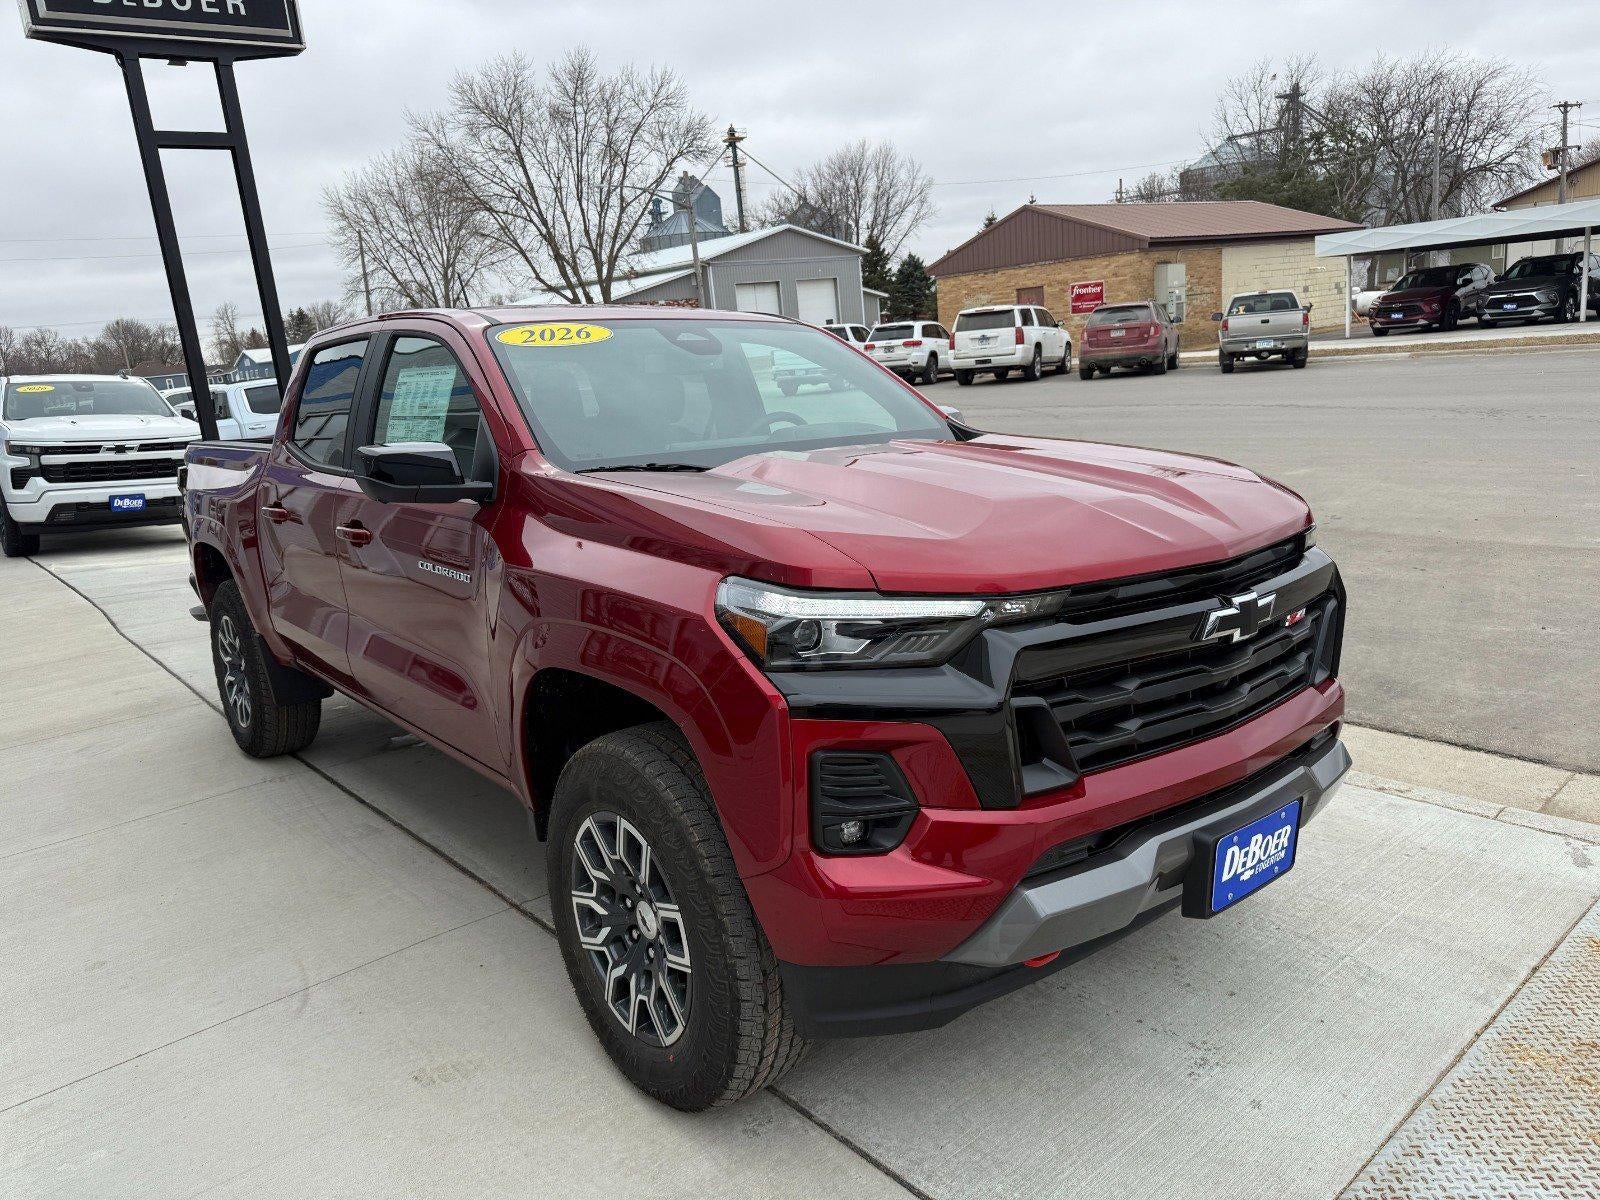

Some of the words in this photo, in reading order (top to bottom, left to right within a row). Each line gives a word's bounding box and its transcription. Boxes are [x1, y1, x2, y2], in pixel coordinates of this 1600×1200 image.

[520, 326, 592, 344] 2026
[418, 561, 471, 583] COLORADO
[1254, 848, 1286, 875] EDGERTON
